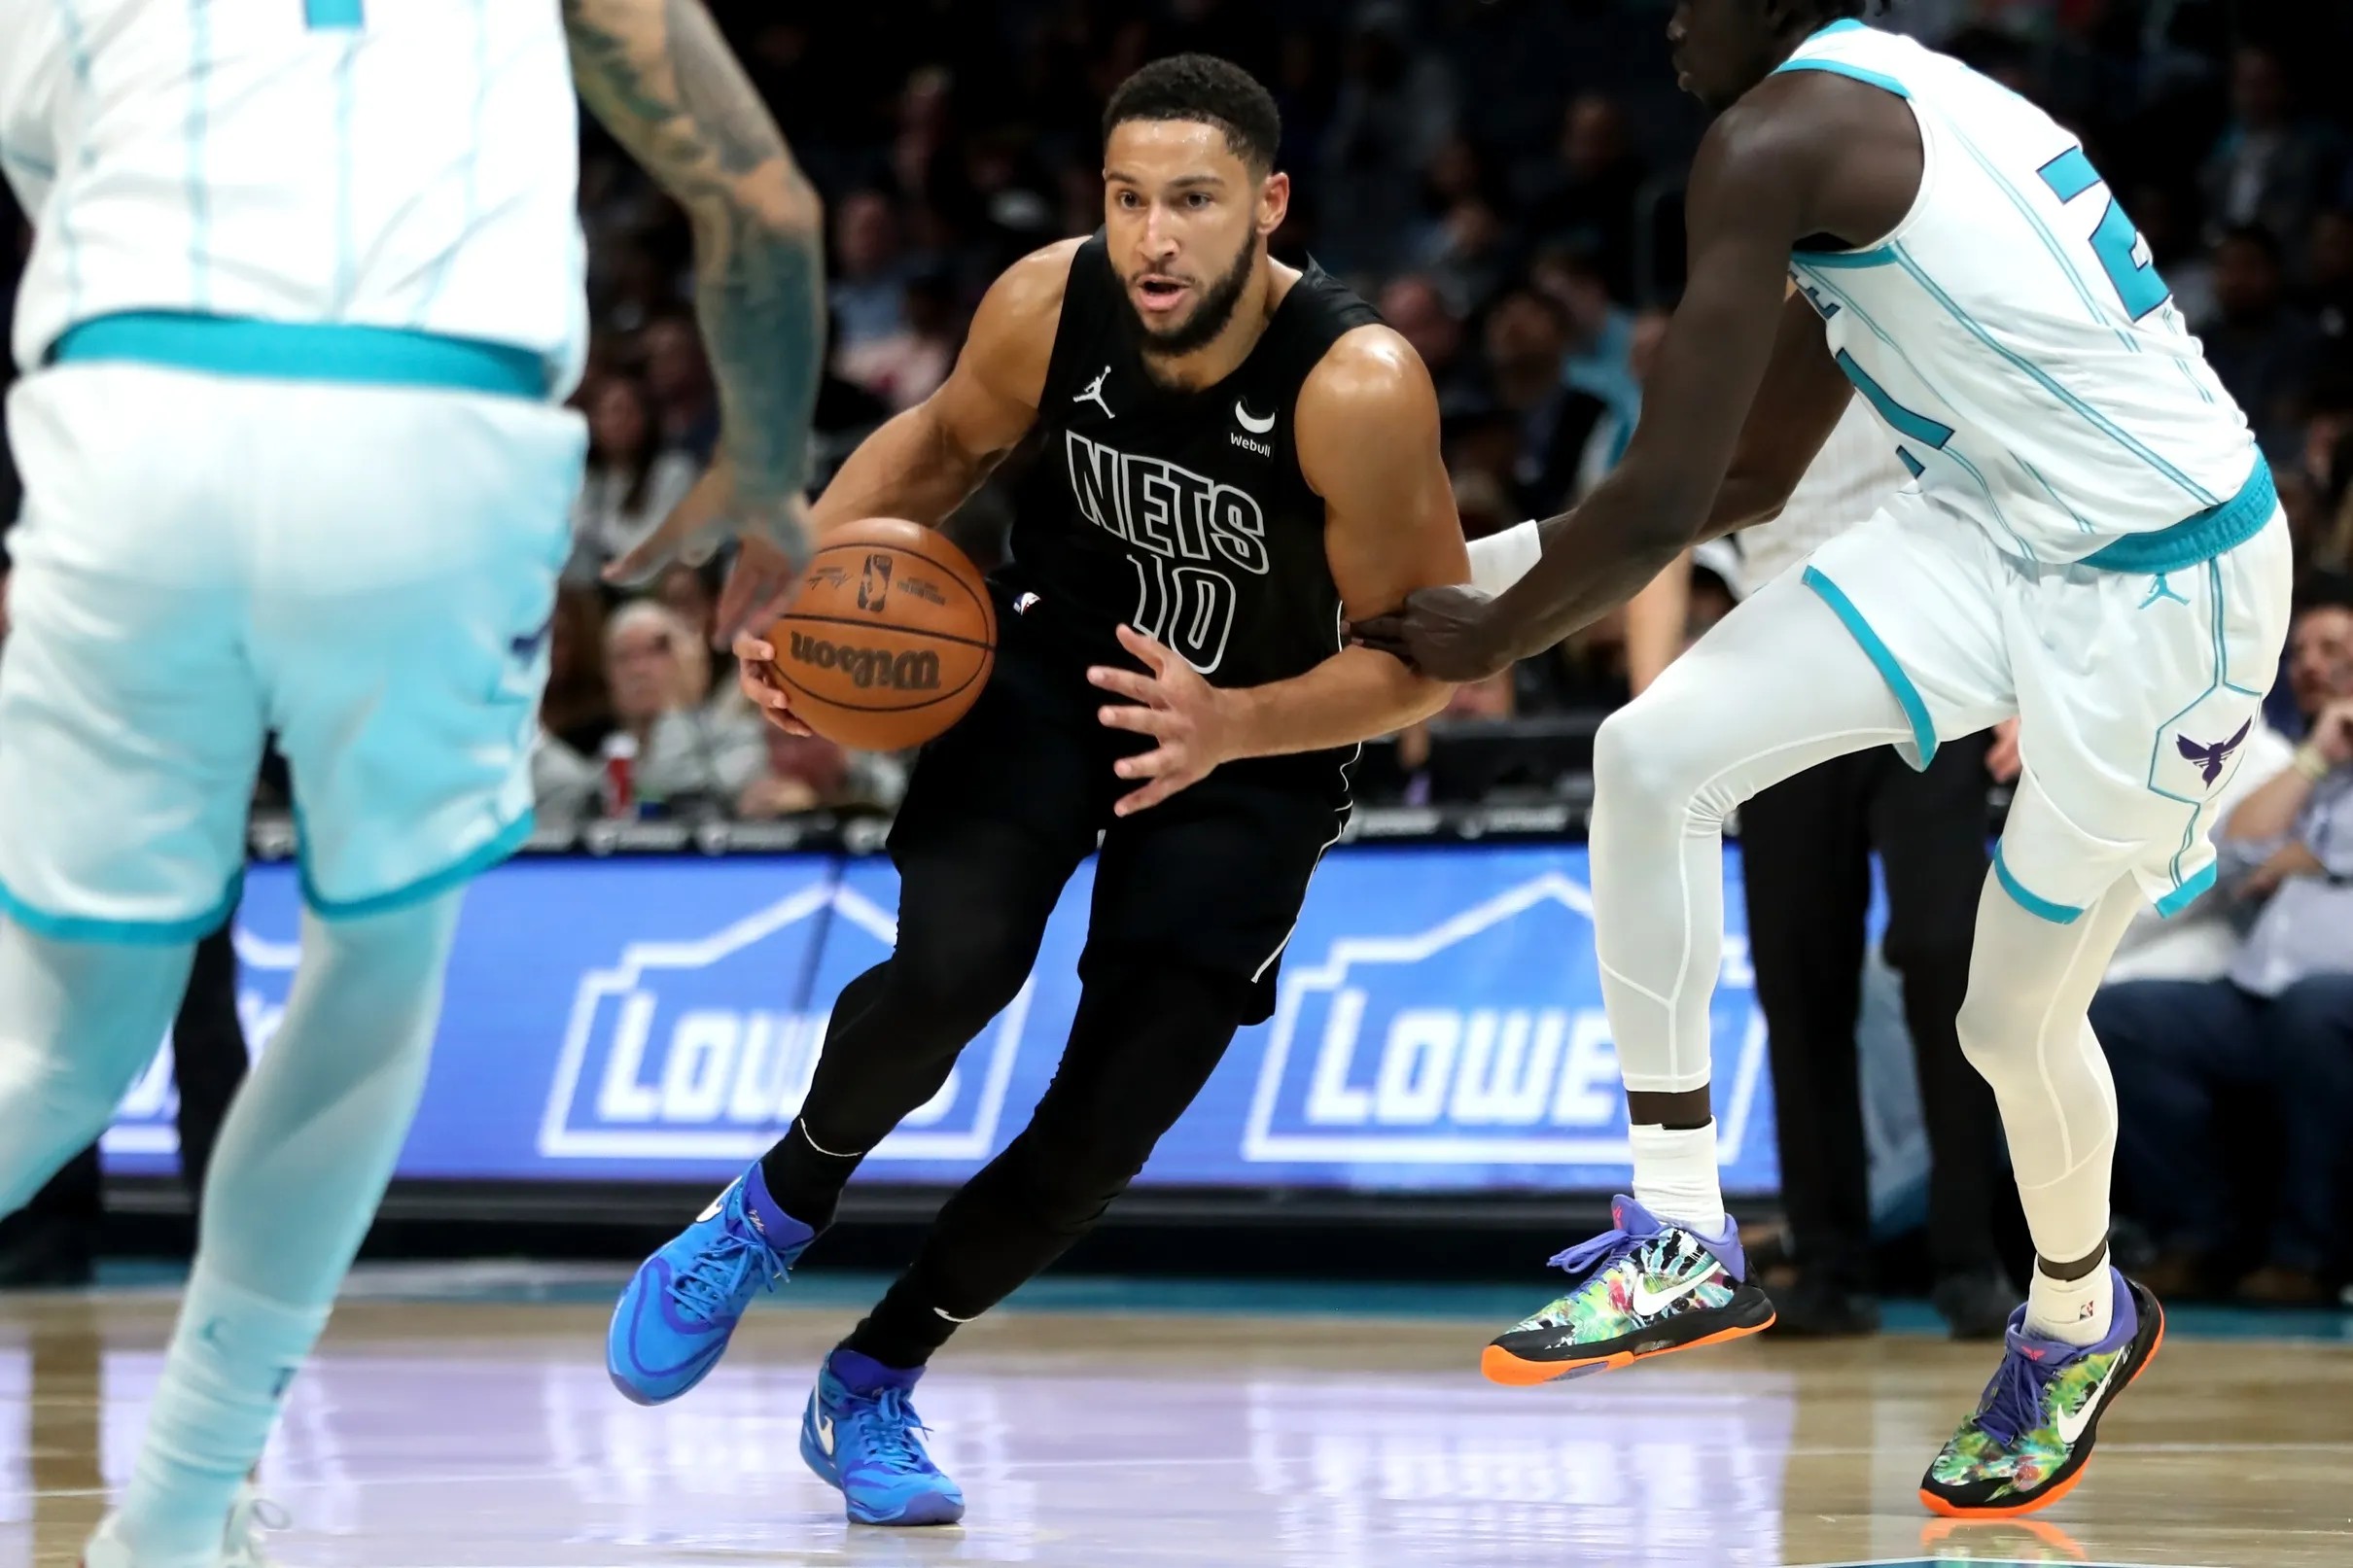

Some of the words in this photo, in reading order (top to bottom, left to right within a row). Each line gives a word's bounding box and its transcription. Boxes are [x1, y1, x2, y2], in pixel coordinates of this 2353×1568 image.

[1067, 429, 1270, 575] NETS
[1230, 433, 1271, 458] Webull
[790, 630, 940, 689] Wilson
[1126, 554, 1236, 674] 10
[1306, 985, 1622, 1125] LOWE
